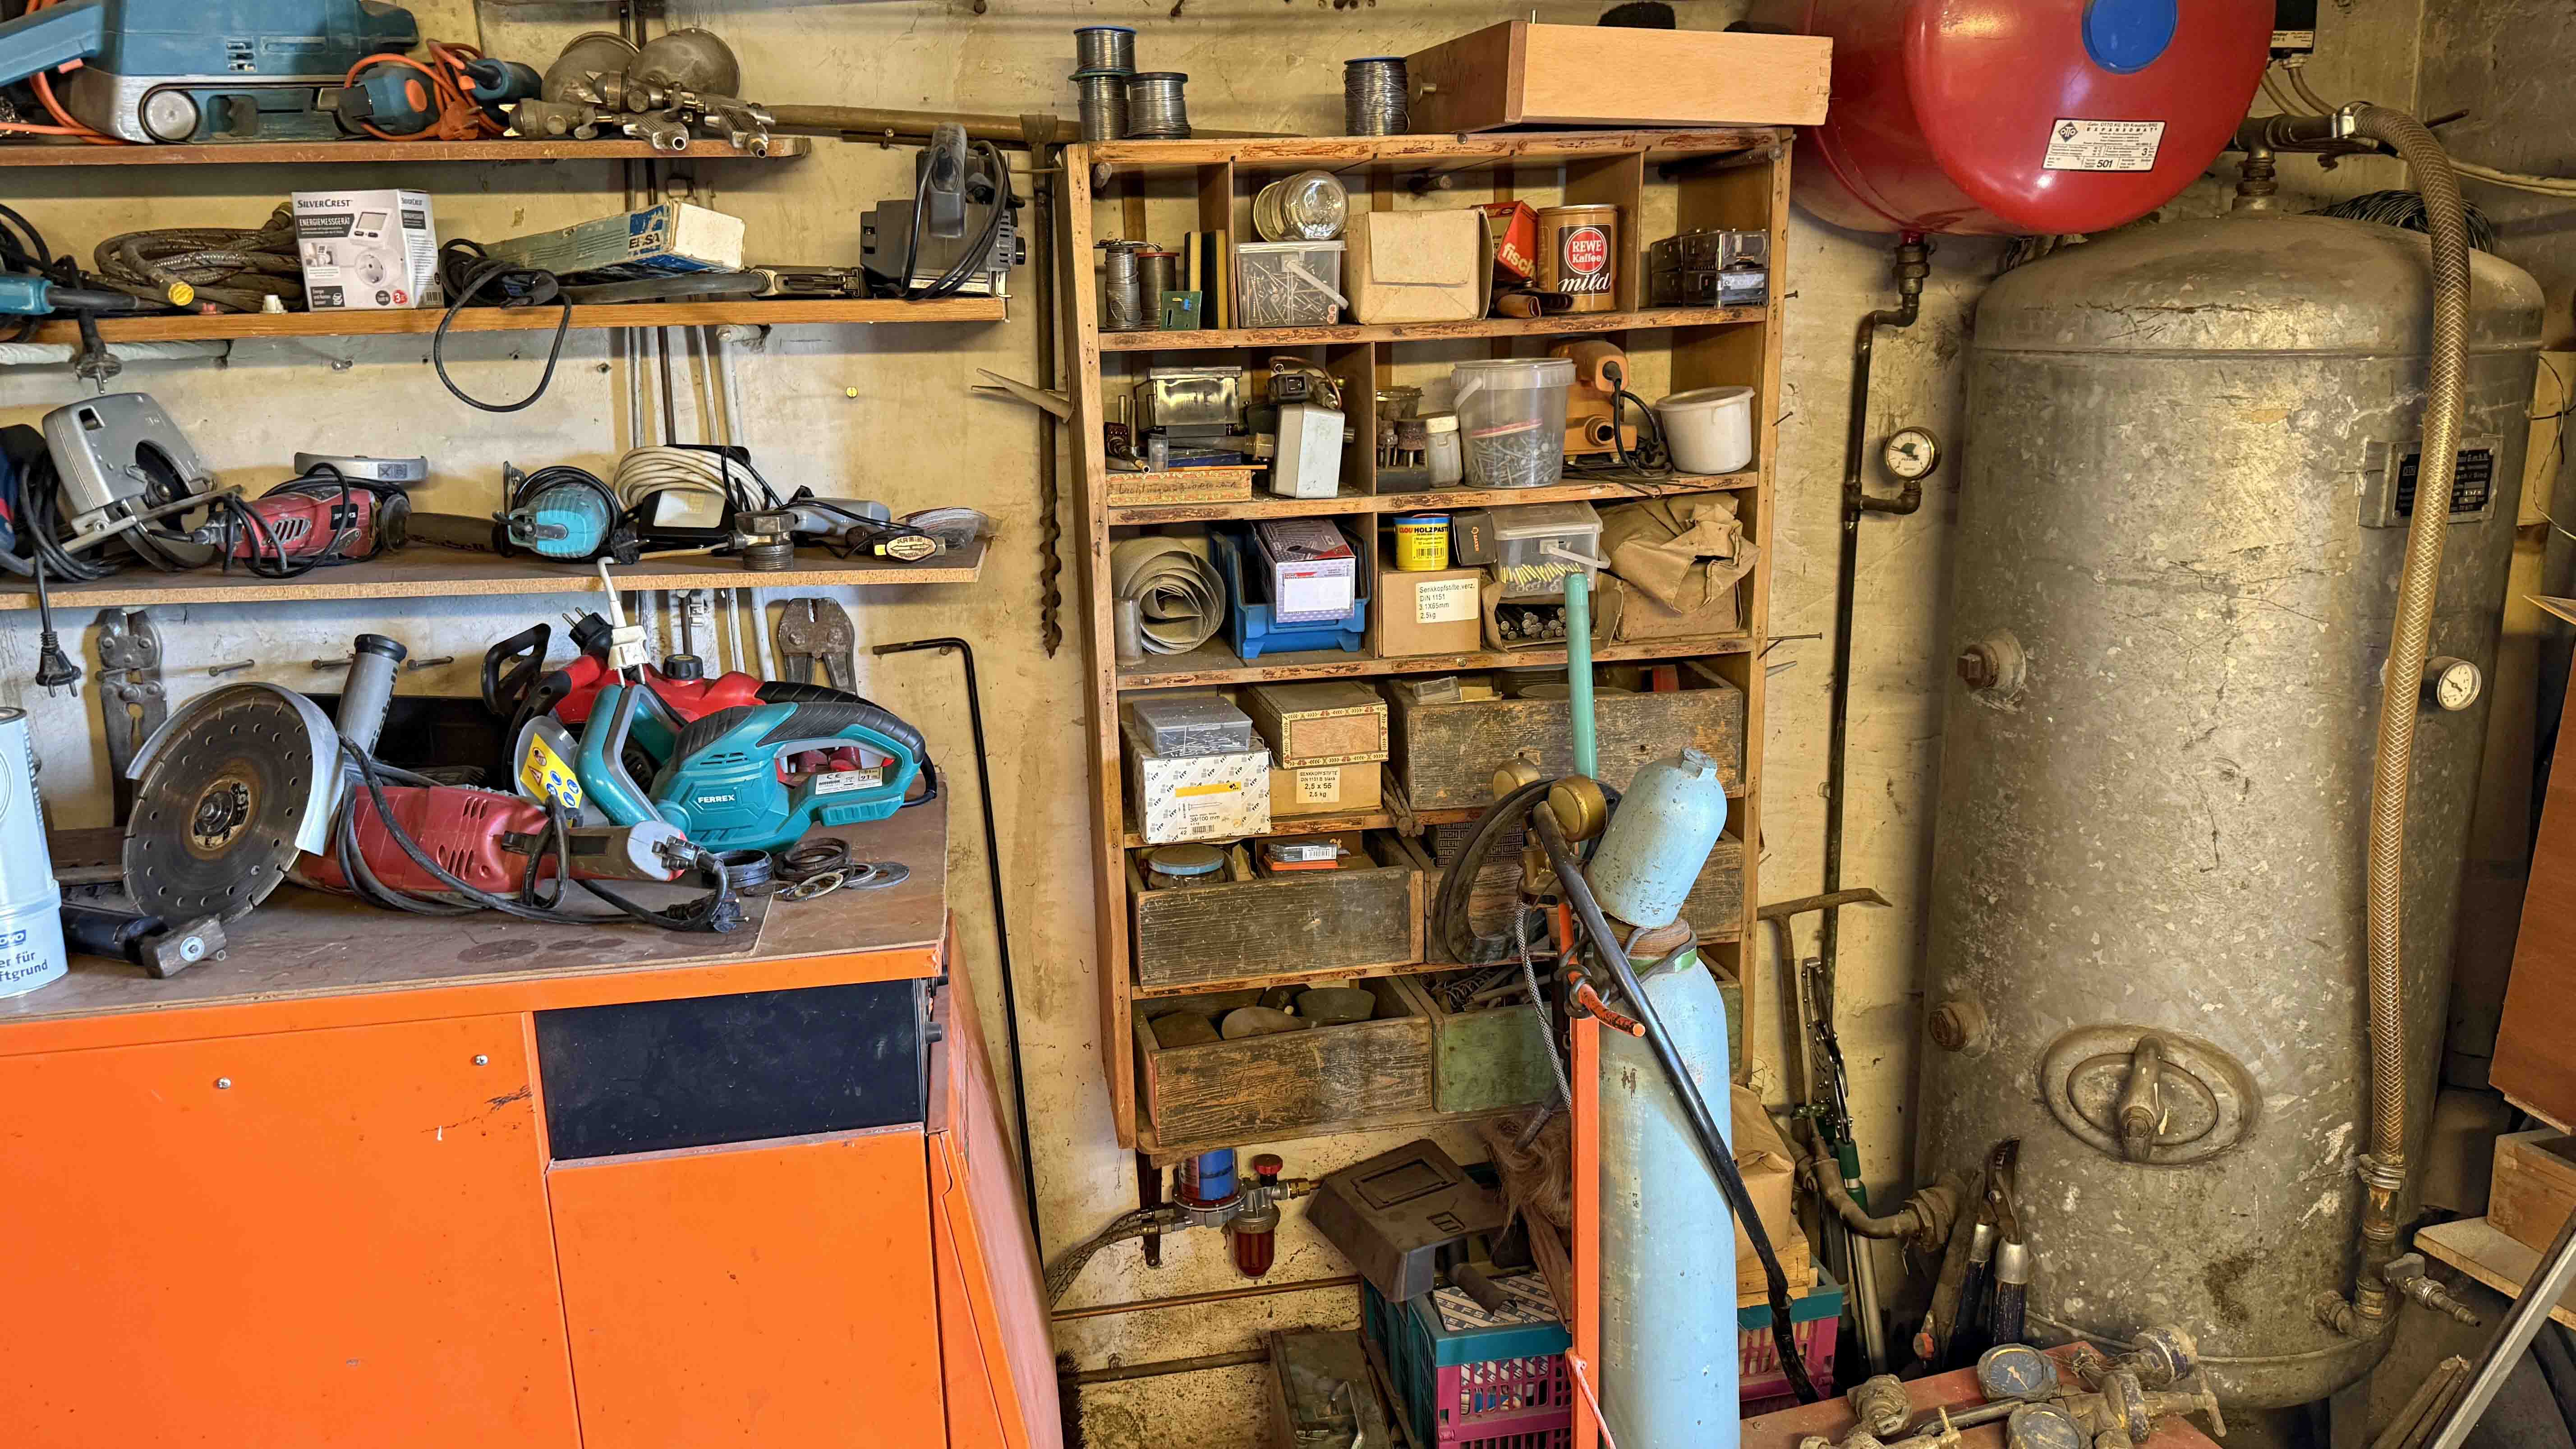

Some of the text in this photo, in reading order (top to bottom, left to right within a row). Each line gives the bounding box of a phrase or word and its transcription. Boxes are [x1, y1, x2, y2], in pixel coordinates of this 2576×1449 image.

[2141, 148, 2148, 156] 3
[2097, 160, 2113, 168] 501
[1572, 240, 1602, 253] REWE
[1572, 253, 1602, 263] Kaffee
[1558, 272, 1610, 292] mild
[698, 794, 736, 804] FERREX
[15, 951, 35, 964] für
